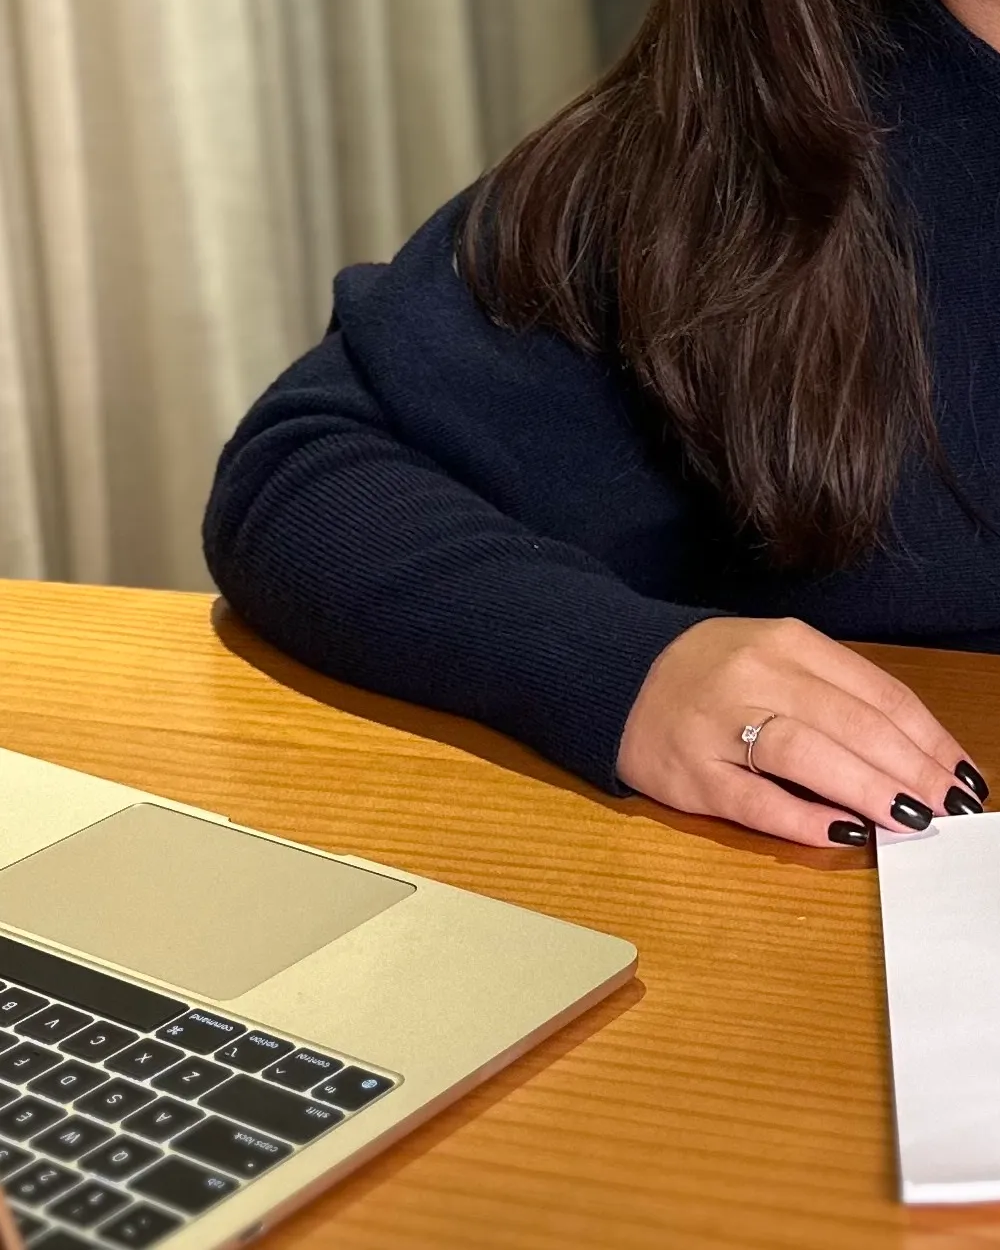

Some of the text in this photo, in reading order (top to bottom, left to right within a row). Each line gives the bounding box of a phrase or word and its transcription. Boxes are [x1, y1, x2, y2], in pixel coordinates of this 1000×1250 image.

[1, 1001, 18, 1011] B
[44, 1018, 60, 1029] V
[189, 1012, 234, 1032] command
[89, 1035, 106, 1045] C
[248, 1035, 279, 1049] option
[13, 1058, 31, 1067] F
[134, 1052, 153, 1064] X
[295, 1052, 331, 1068] control
[60, 1075, 77, 1086] D
[181, 1071, 201, 1083] Z
[106, 1094, 123, 1104] S
[15, 1111, 34, 1122] E
[155, 1112, 172, 1123] A
[305, 1105, 330, 1119] shift
[59, 1131, 81, 1144] W
[234, 1131, 279, 1152] caps lock
[111, 1150, 129, 1162] Q
[39, 1170, 58, 1182] 2
